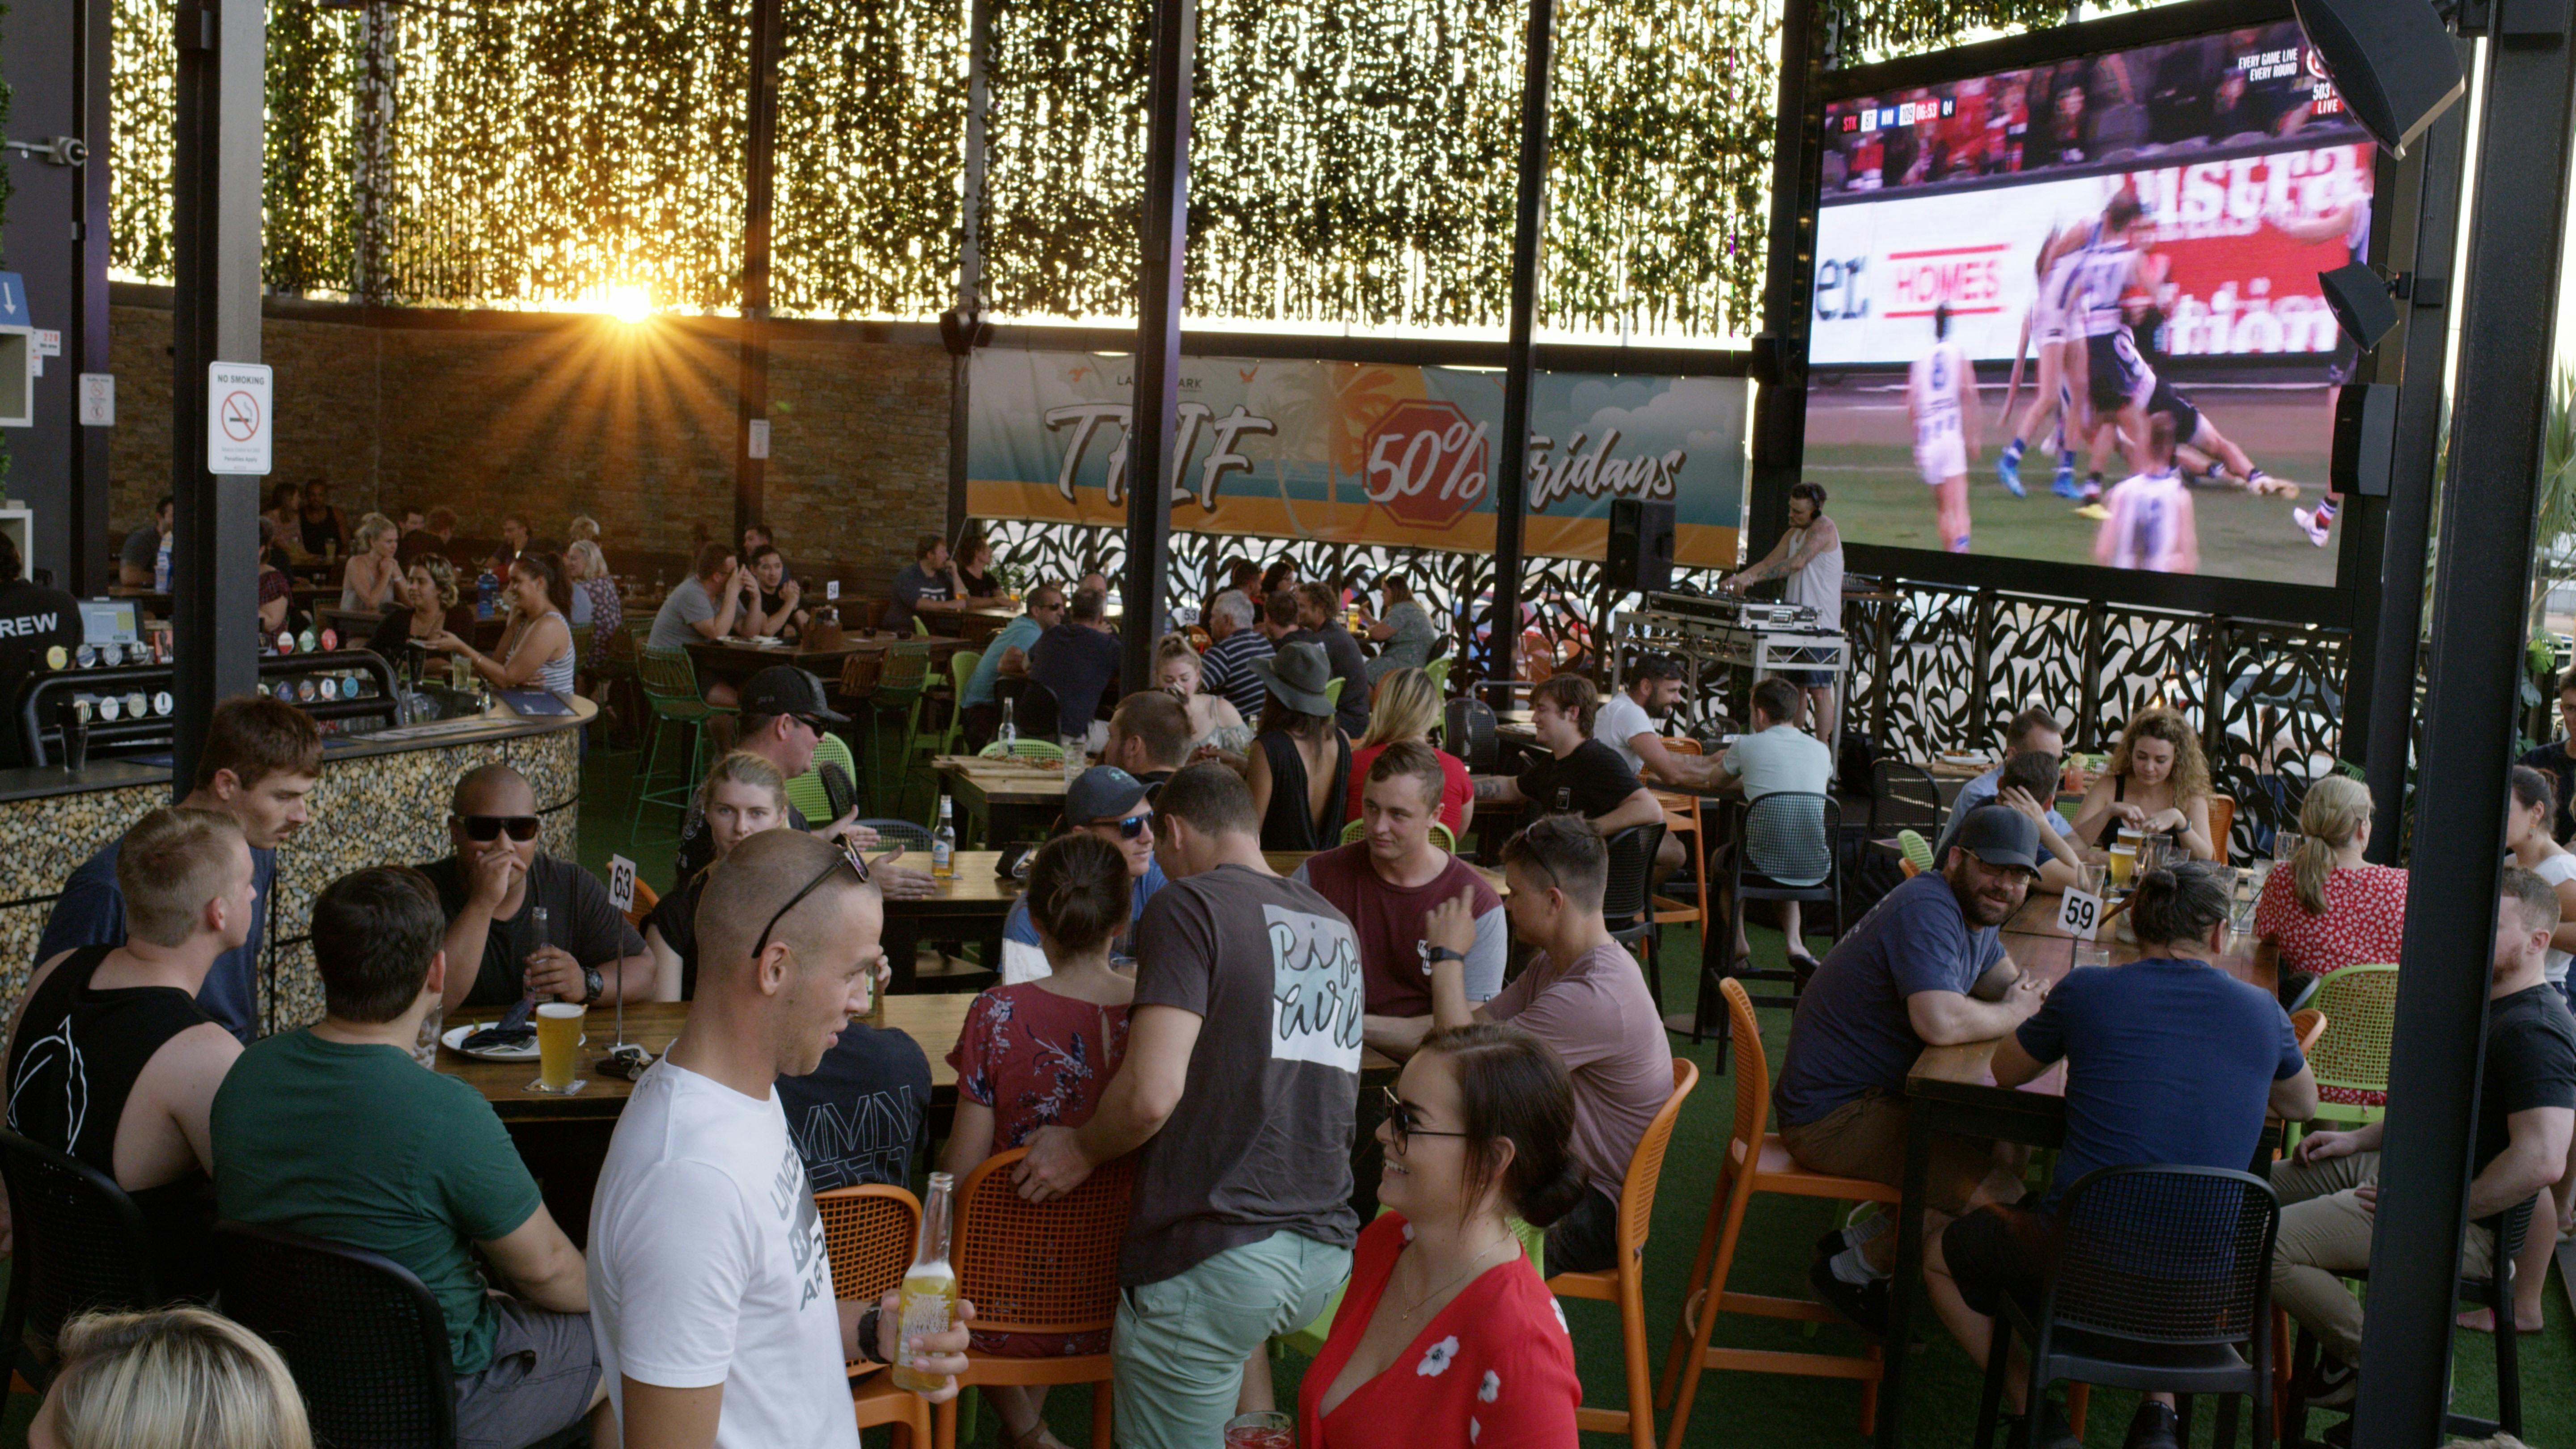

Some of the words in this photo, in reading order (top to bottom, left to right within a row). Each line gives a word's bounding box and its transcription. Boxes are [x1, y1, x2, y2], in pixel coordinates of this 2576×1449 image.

[2238, 54, 2260, 70] EVERY
[2261, 51, 2281, 65] GAME
[2282, 47, 2298, 63] LIVE
[2250, 66, 2272, 82] EVERY
[2273, 62, 2297, 77] ROUND
[2313, 82, 2330, 100] 503
[1843, 115, 1857, 132] STK
[1865, 114, 1873, 128] 87
[1881, 109, 1894, 127] NM
[1902, 106, 1913, 121] 109
[1916, 102, 1937, 120] 06:53
[1943, 100, 1953, 116] Q4
[2318, 98, 2338, 114] LIVE
[1897, 259, 2000, 303] HOMES
[217, 375, 228, 383] NO
[230, 375, 265, 385] SMOKING
[1364, 420, 1488, 502] 50%
[1184, 609, 1196, 621] 53
[614, 864, 631, 902] 63
[2065, 896, 2094, 929] 59
[1268, 921, 1360, 990] Rip
